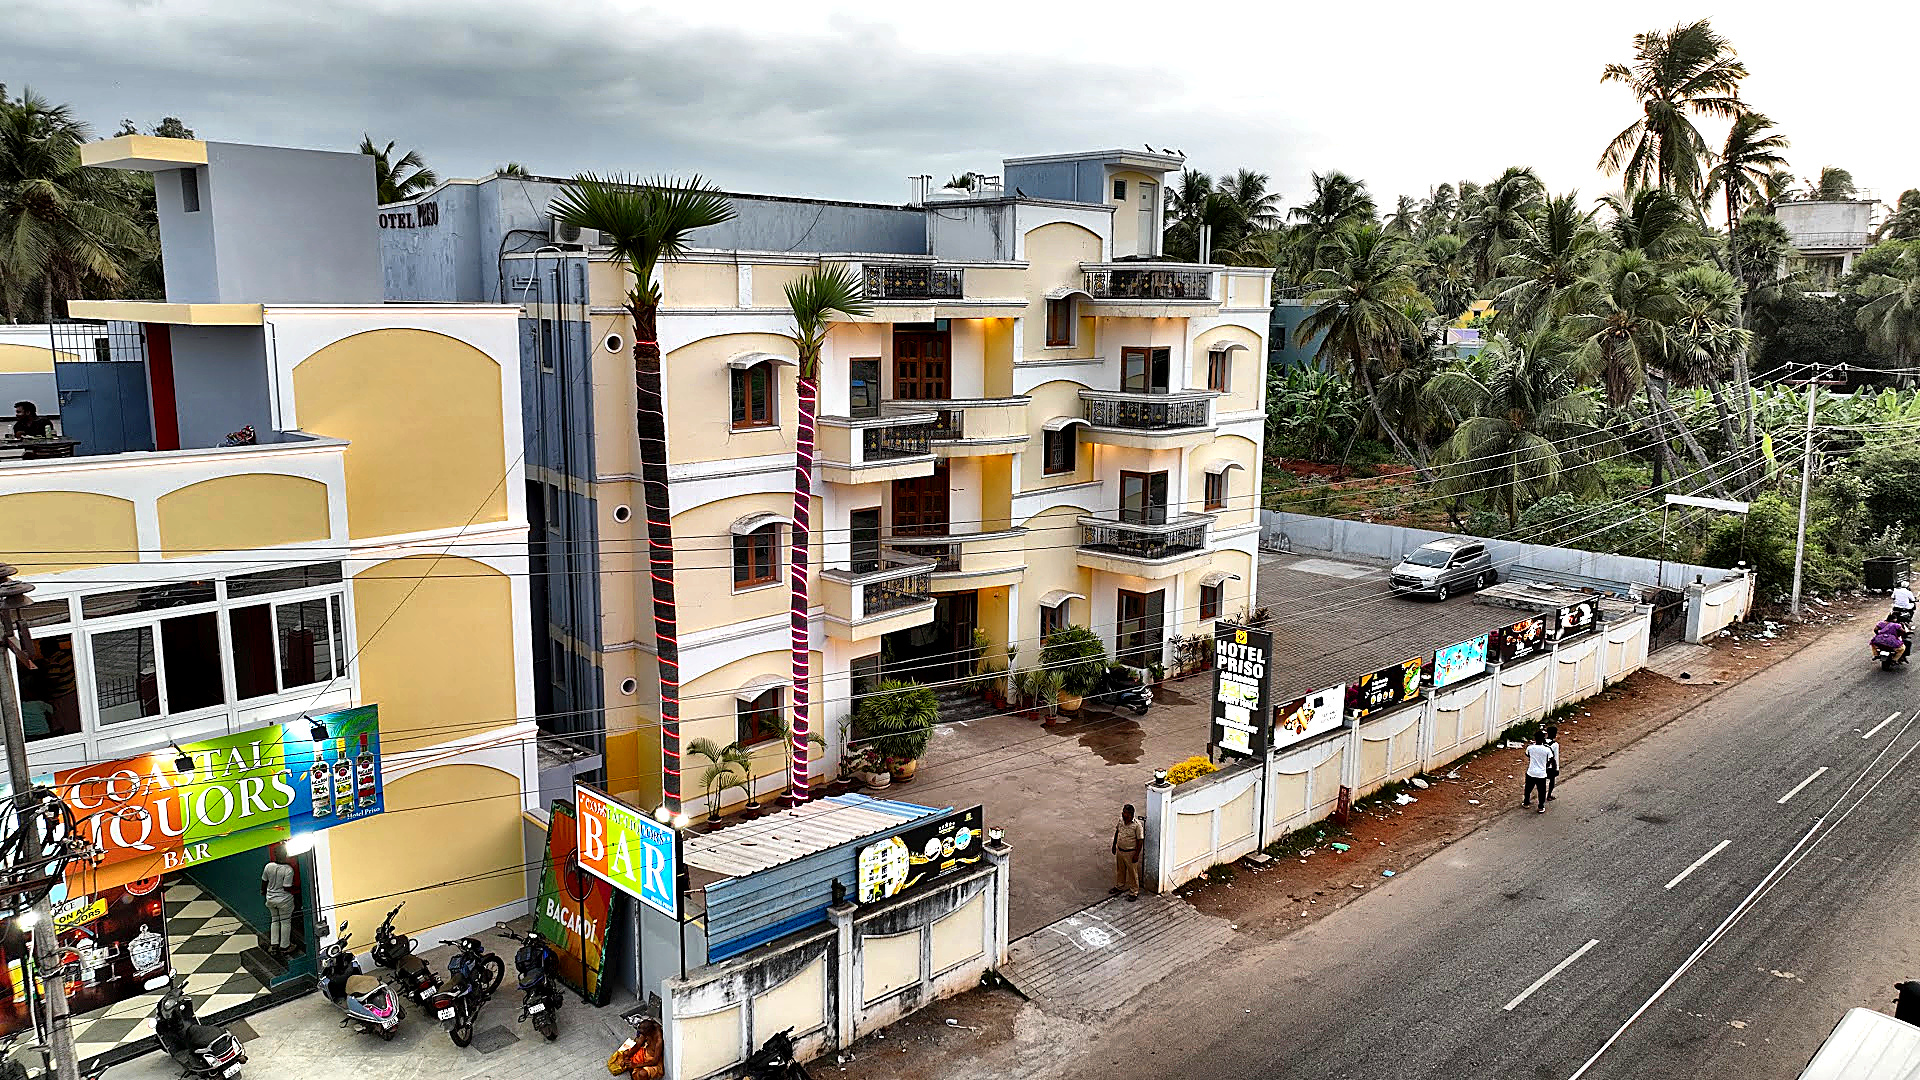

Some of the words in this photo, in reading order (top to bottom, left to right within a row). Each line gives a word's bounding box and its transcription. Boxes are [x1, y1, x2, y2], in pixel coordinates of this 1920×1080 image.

[379, 213, 415, 229] OTEL
[1216, 639, 1266, 664] HOTEL
[1216, 654, 1264, 679] PRISO
[162, 842, 212, 870] BAR
[582, 811, 670, 901] BAR
[58, 912, 74, 924] ON
